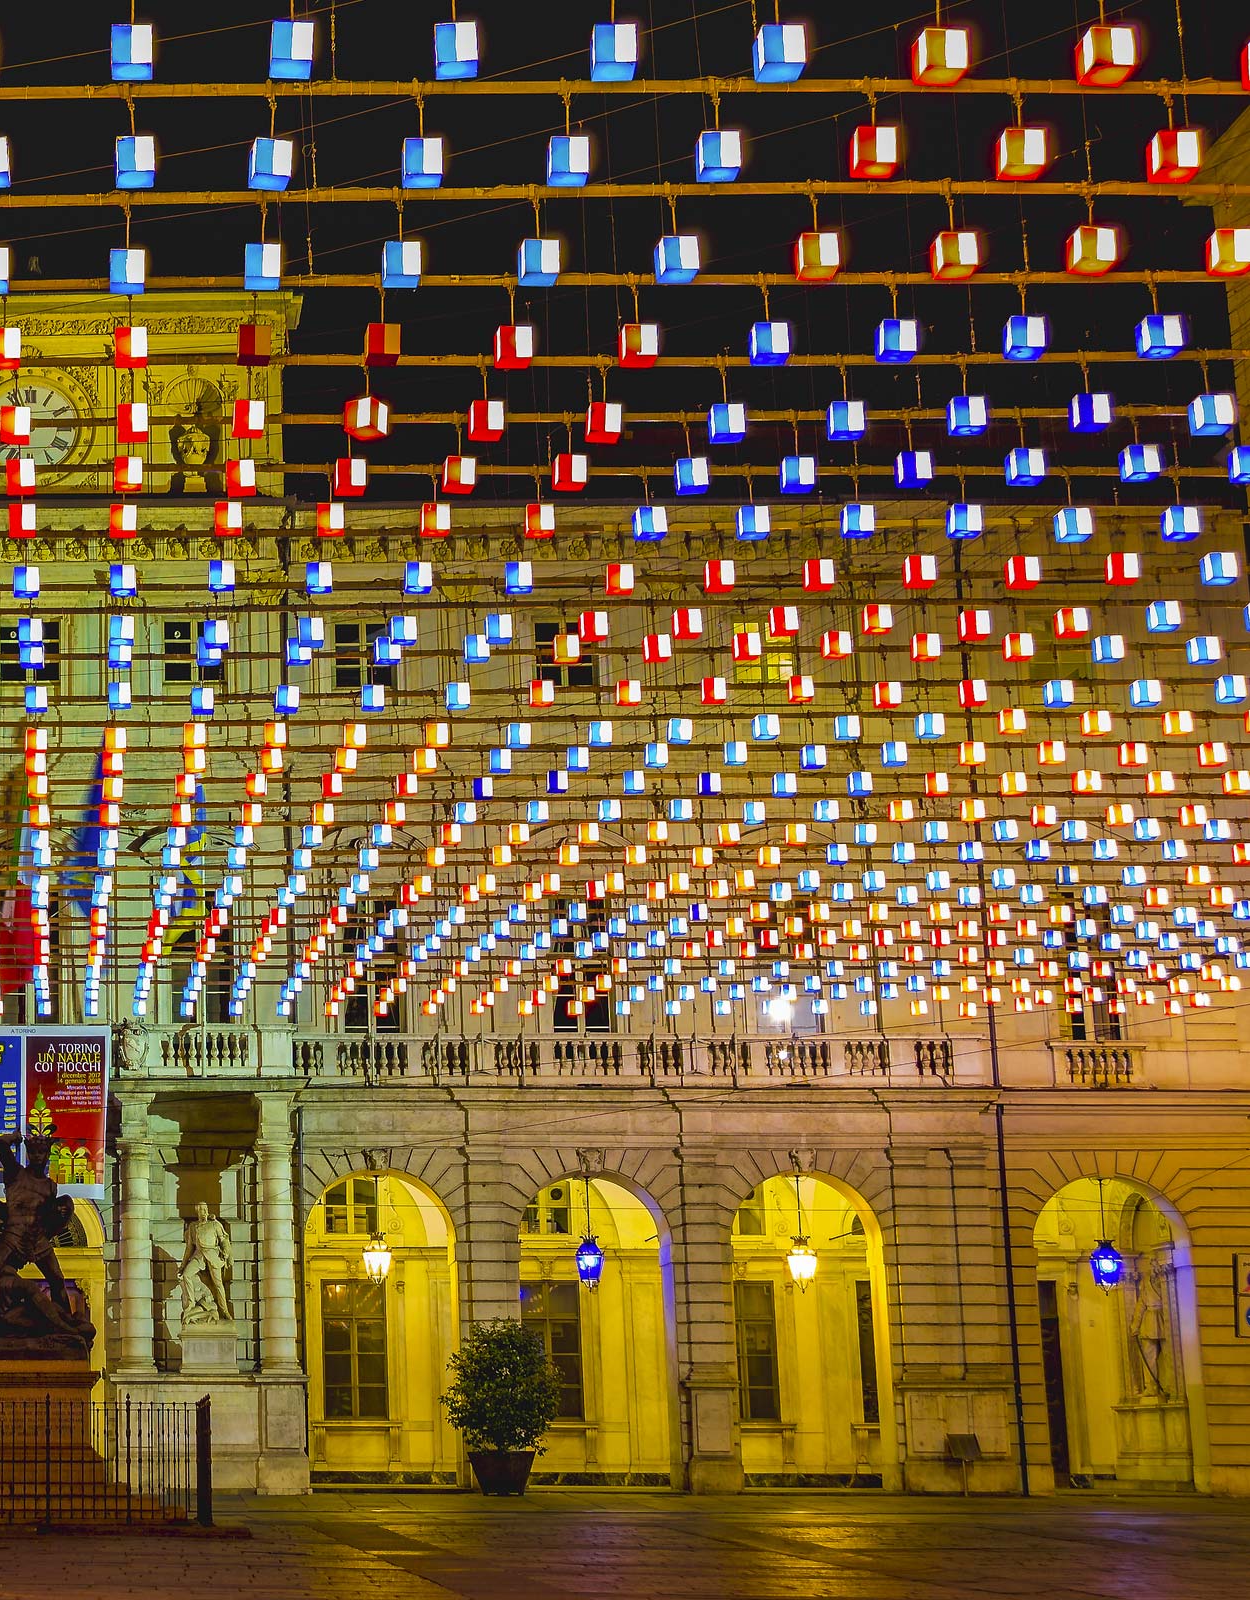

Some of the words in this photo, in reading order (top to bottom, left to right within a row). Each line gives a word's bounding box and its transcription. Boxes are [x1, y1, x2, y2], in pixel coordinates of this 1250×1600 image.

[48, 1044, 56, 1053] A
[59, 1044, 100, 1053] TORINO
[38, 1053, 54, 1062] UN
[58, 1053, 101, 1062] NATALE
[34, 1062, 52, 1072] COI
[57, 1062, 100, 1072] FIOCCHI
